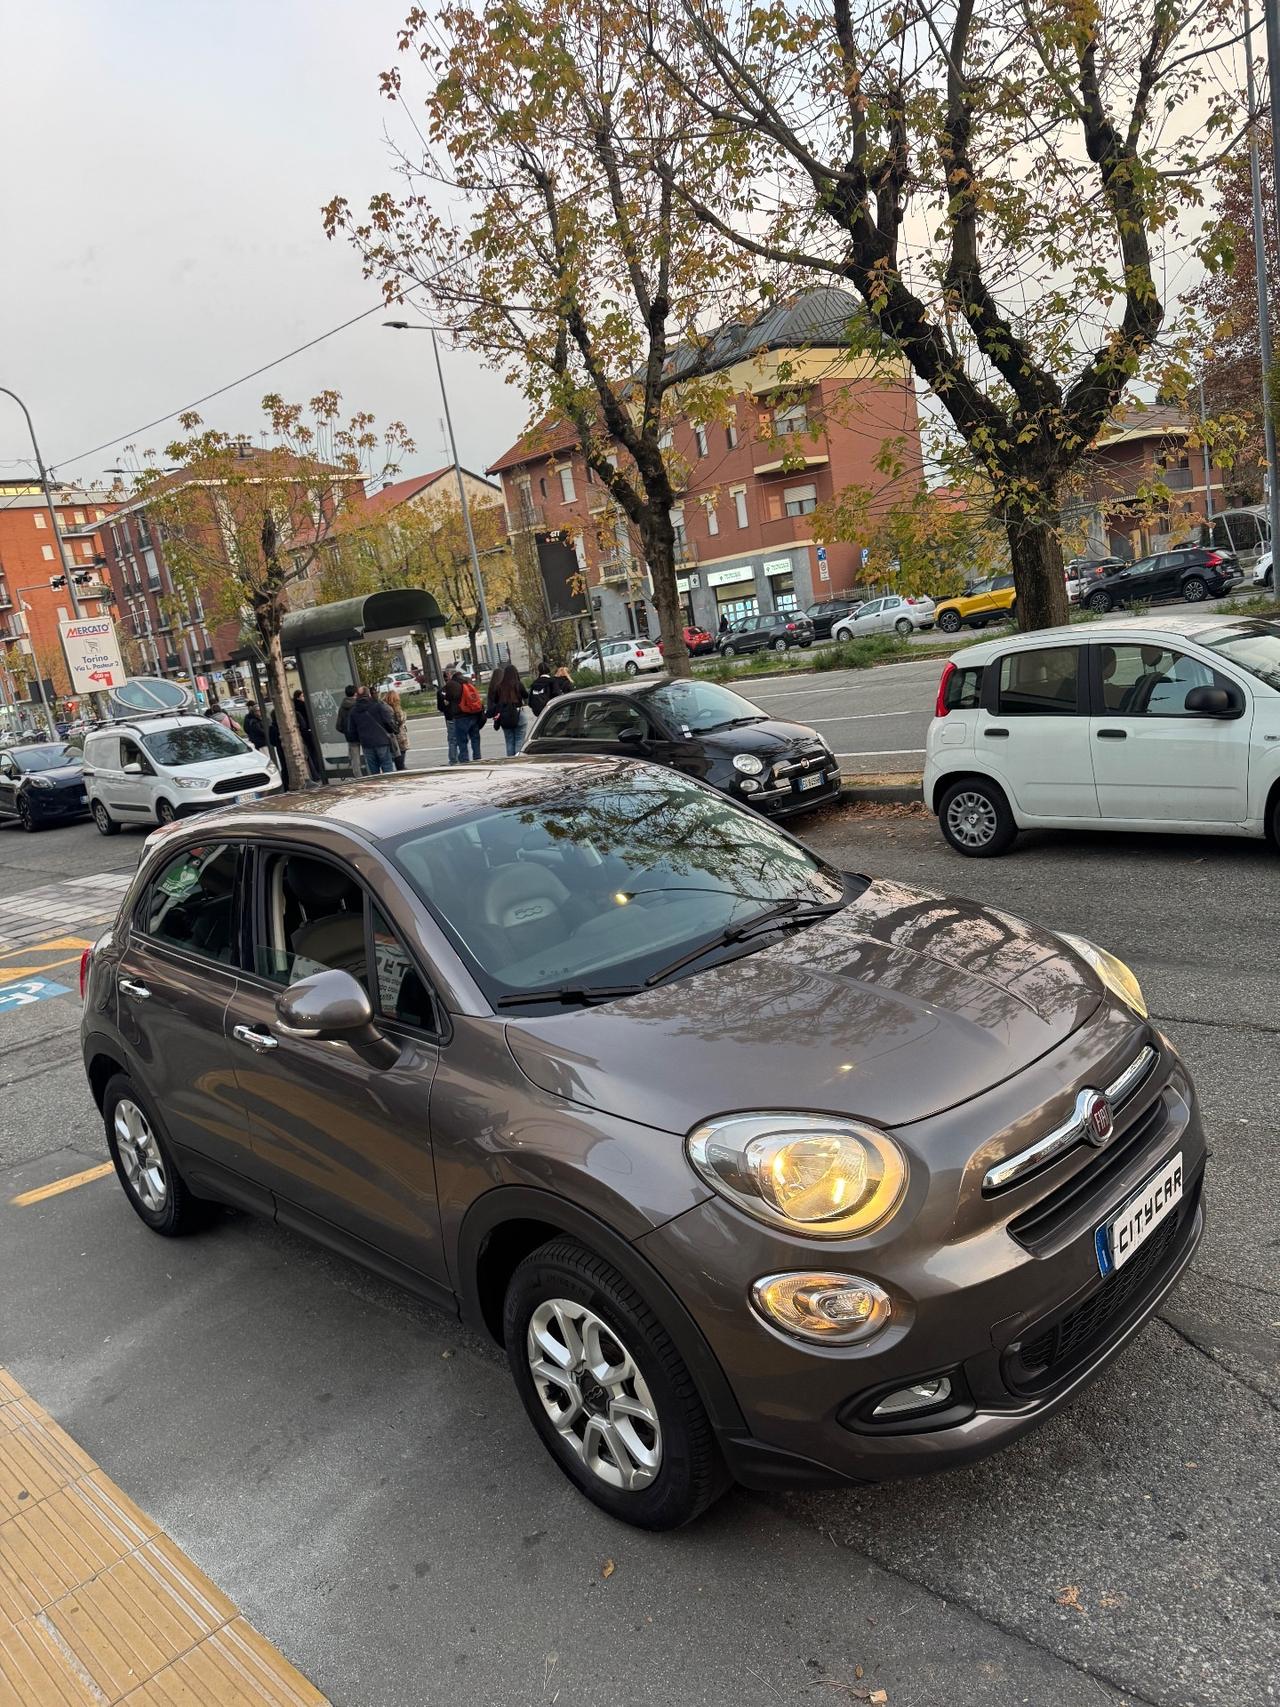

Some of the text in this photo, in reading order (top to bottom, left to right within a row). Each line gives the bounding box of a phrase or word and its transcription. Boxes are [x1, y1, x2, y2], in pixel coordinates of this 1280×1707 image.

[82, 655, 109, 664] Torino
[1094, 1105, 1109, 1132] FIAT
[1119, 1166, 1182, 1254] CITYCAR
